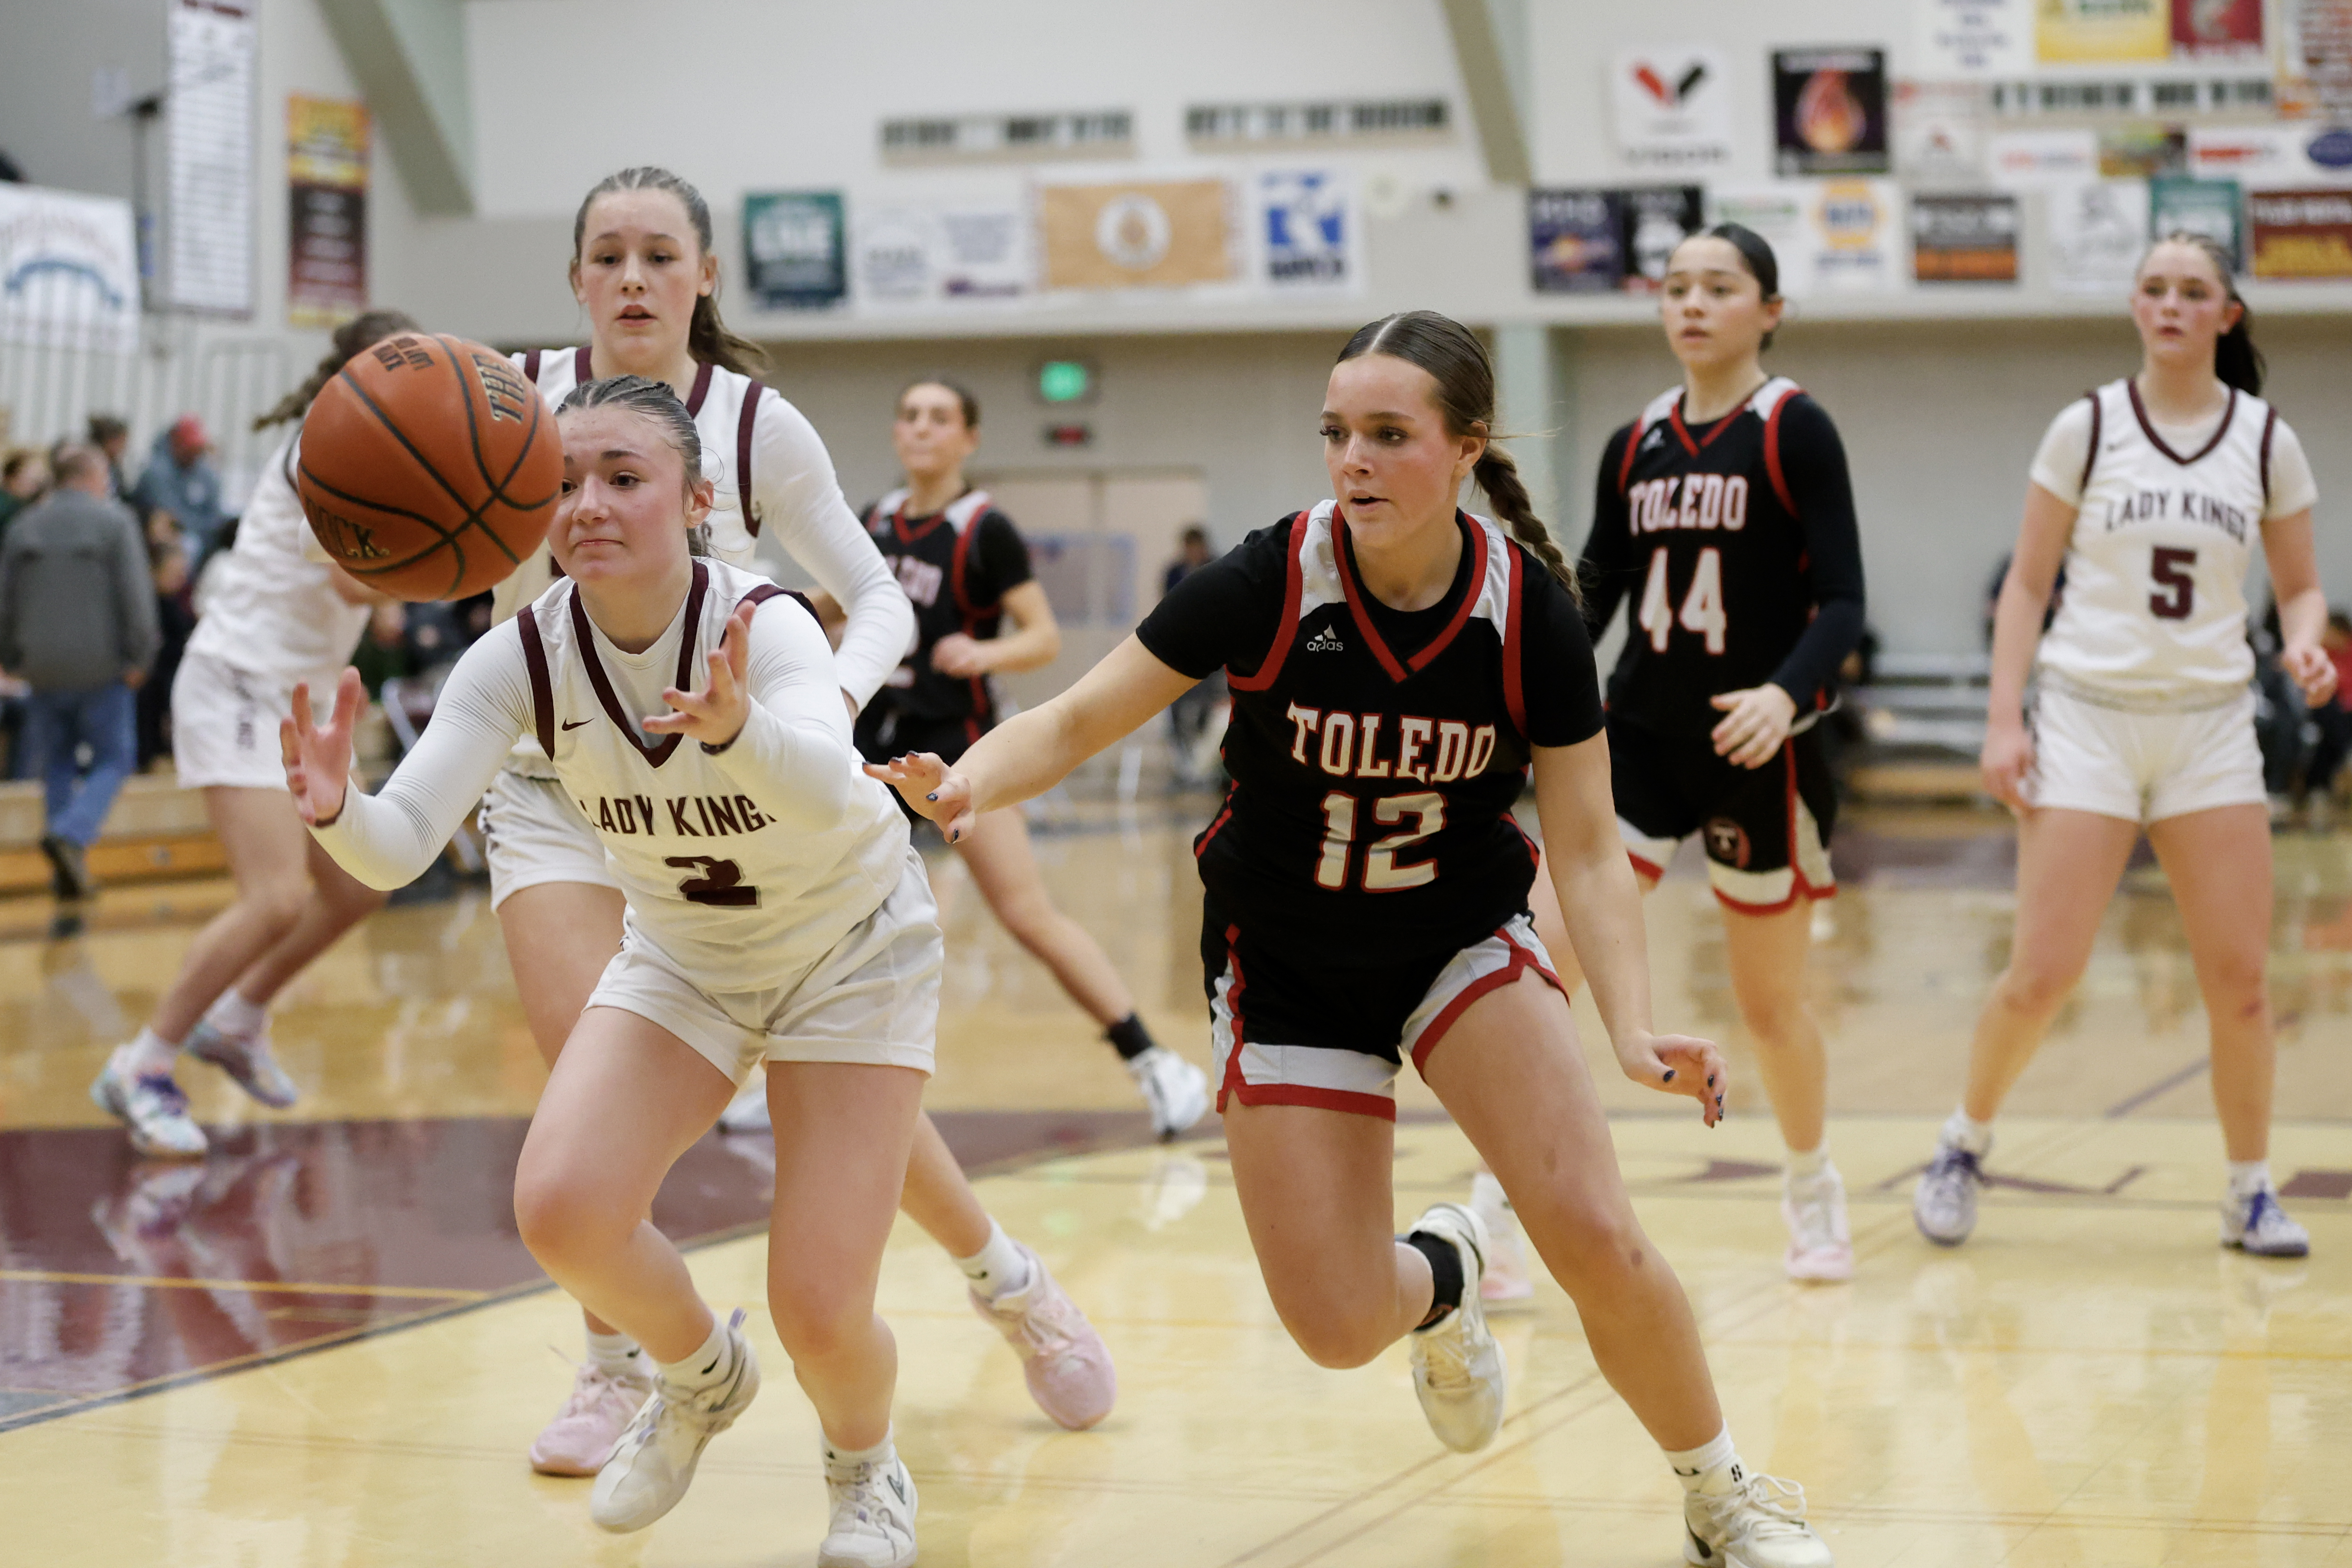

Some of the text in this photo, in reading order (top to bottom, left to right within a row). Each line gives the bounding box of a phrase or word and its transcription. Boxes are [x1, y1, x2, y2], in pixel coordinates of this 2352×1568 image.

[1628, 472, 1749, 537] TOLEDO
[2106, 490, 2170, 532] LADY
[1638, 545, 1728, 654] 44
[2150, 546, 2196, 619] 5
[1307, 638, 1344, 652] adas
[1286, 698, 1496, 785] TOLEDO
[665, 794, 778, 837] KING
[1314, 789, 1448, 893] 12
[661, 855, 762, 909] 2
